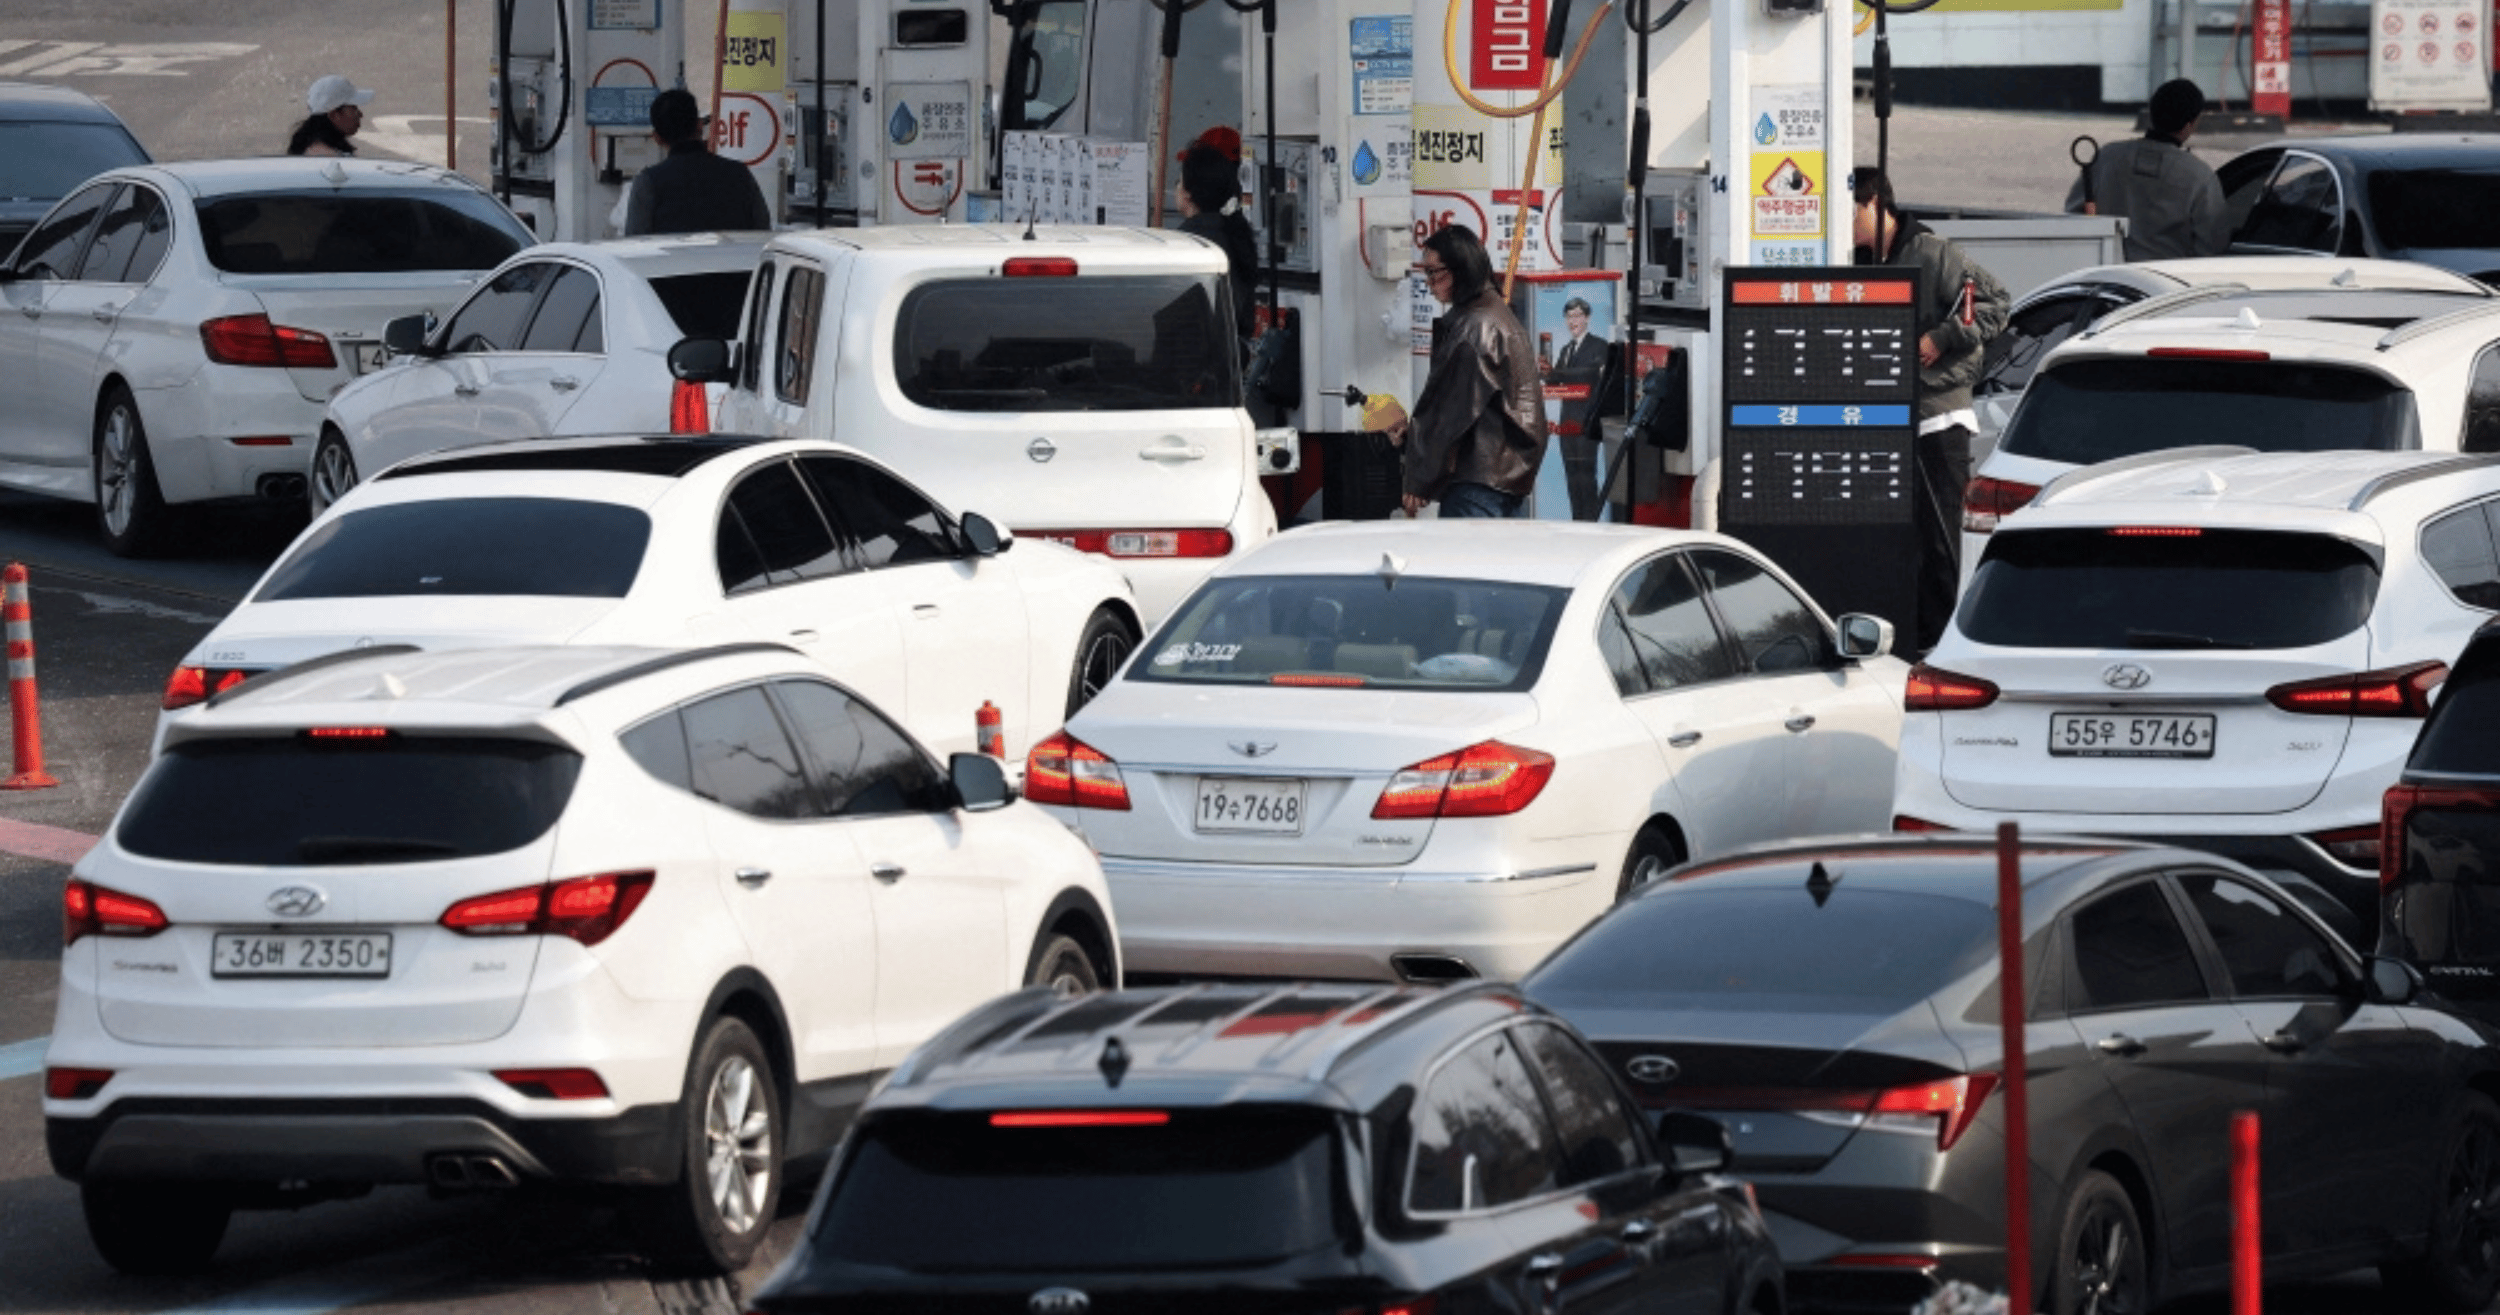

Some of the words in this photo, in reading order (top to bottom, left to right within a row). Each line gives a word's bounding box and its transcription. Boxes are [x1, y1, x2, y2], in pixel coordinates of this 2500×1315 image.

[1321, 146, 1337, 164] 10
[1710, 174, 1728, 194] 14
[1779, 281, 1866, 303] 휘발유
[1777, 405, 1863, 426] 경유
[2065, 719, 2116, 747] 55우
[2129, 719, 2198, 747] 5746
[229, 939, 286, 967] 36버
[299, 939, 373, 967] 2350
